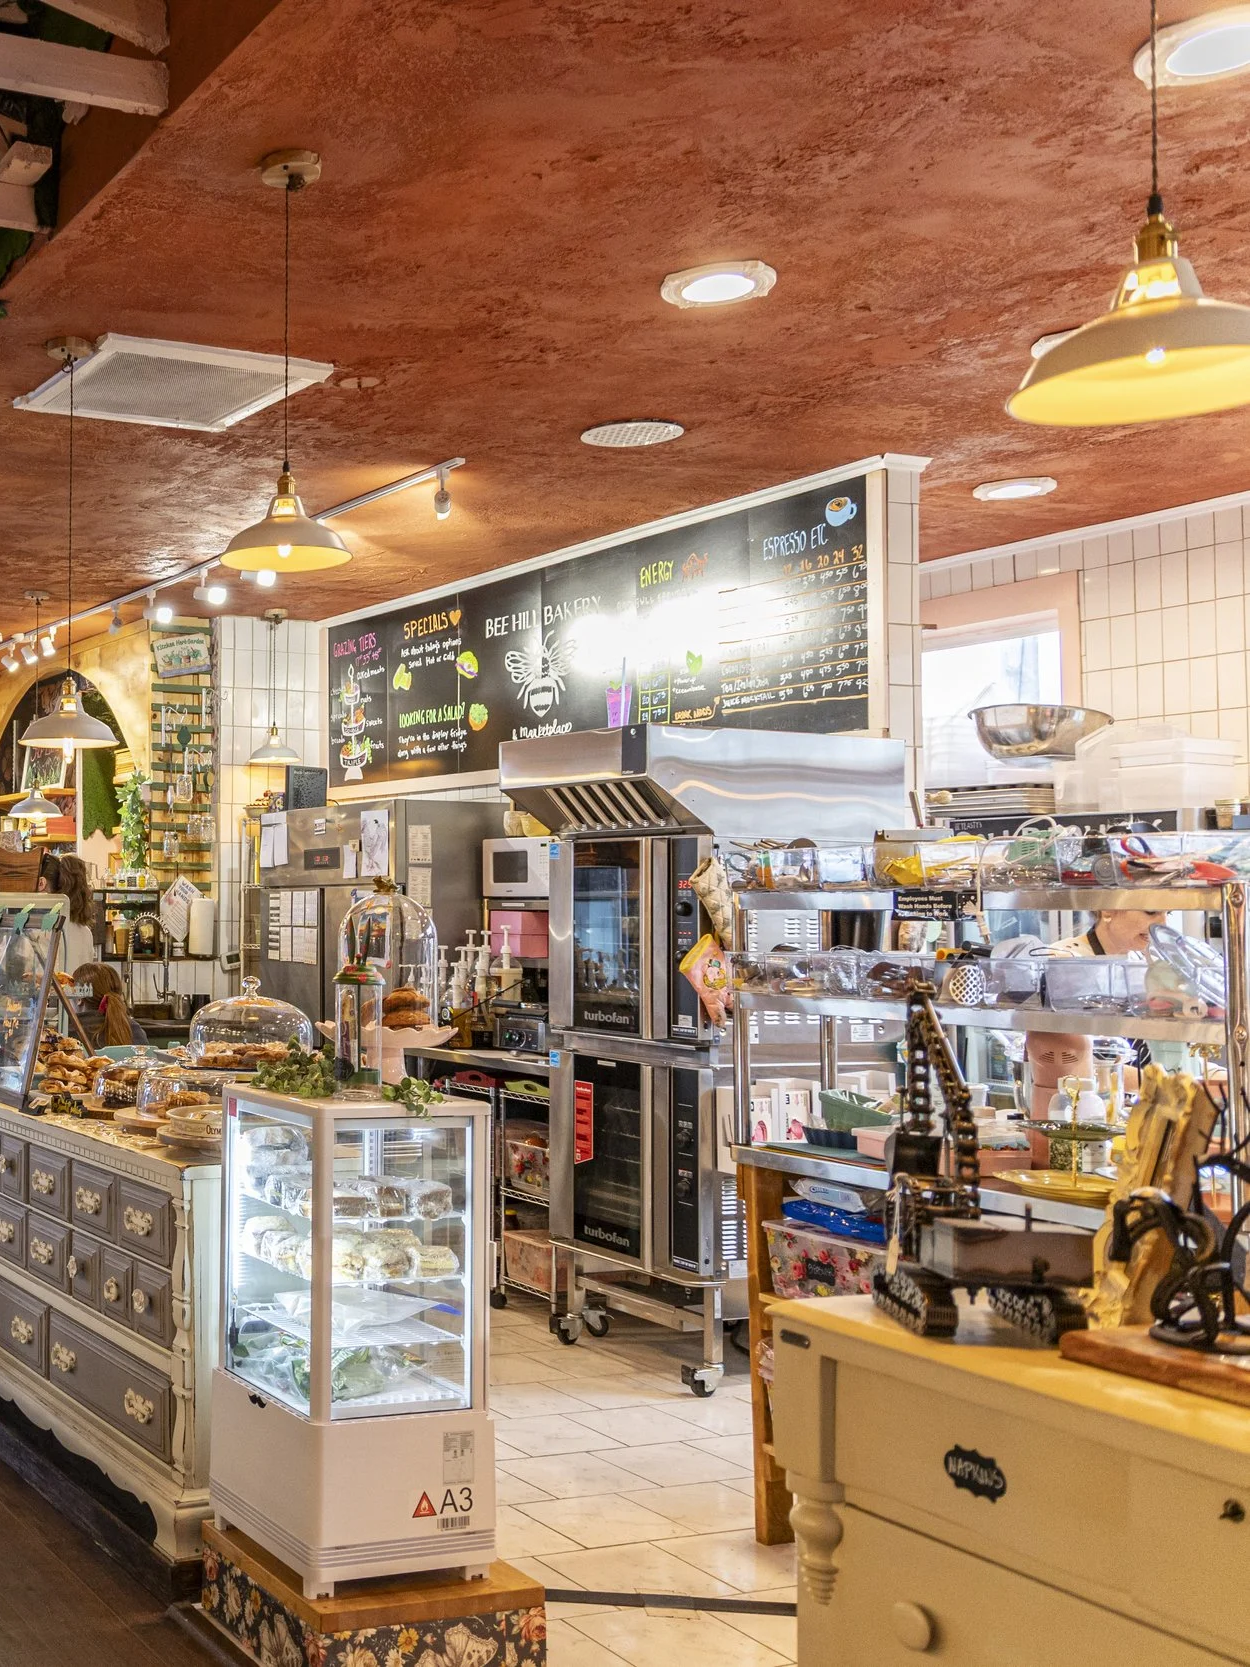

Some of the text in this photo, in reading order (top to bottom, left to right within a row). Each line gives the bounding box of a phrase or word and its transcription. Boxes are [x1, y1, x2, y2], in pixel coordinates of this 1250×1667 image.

[763, 523, 829, 561] ESPRESSO ETC
[817, 555, 830, 568] 20
[833, 549, 845, 564] 24
[640, 560, 674, 588] ENERGY
[403, 611, 448, 640] SPECIALS
[485, 615, 509, 639] BEE
[512, 608, 540, 631] HILL
[544, 595, 601, 626] BAKERY
[333, 639, 357, 658] GRAZING
[400, 648, 410, 658] Ask
[442, 637, 462, 650] options
[399, 709, 425, 729] LOOKING
[520, 719, 573, 738] Marketplace
[584, 1010, 630, 1025] turbofan
[584, 1225, 630, 1248] turbofan
[948, 1455, 1003, 1489] NAPKINS
[439, 1487, 473, 1514] A3
